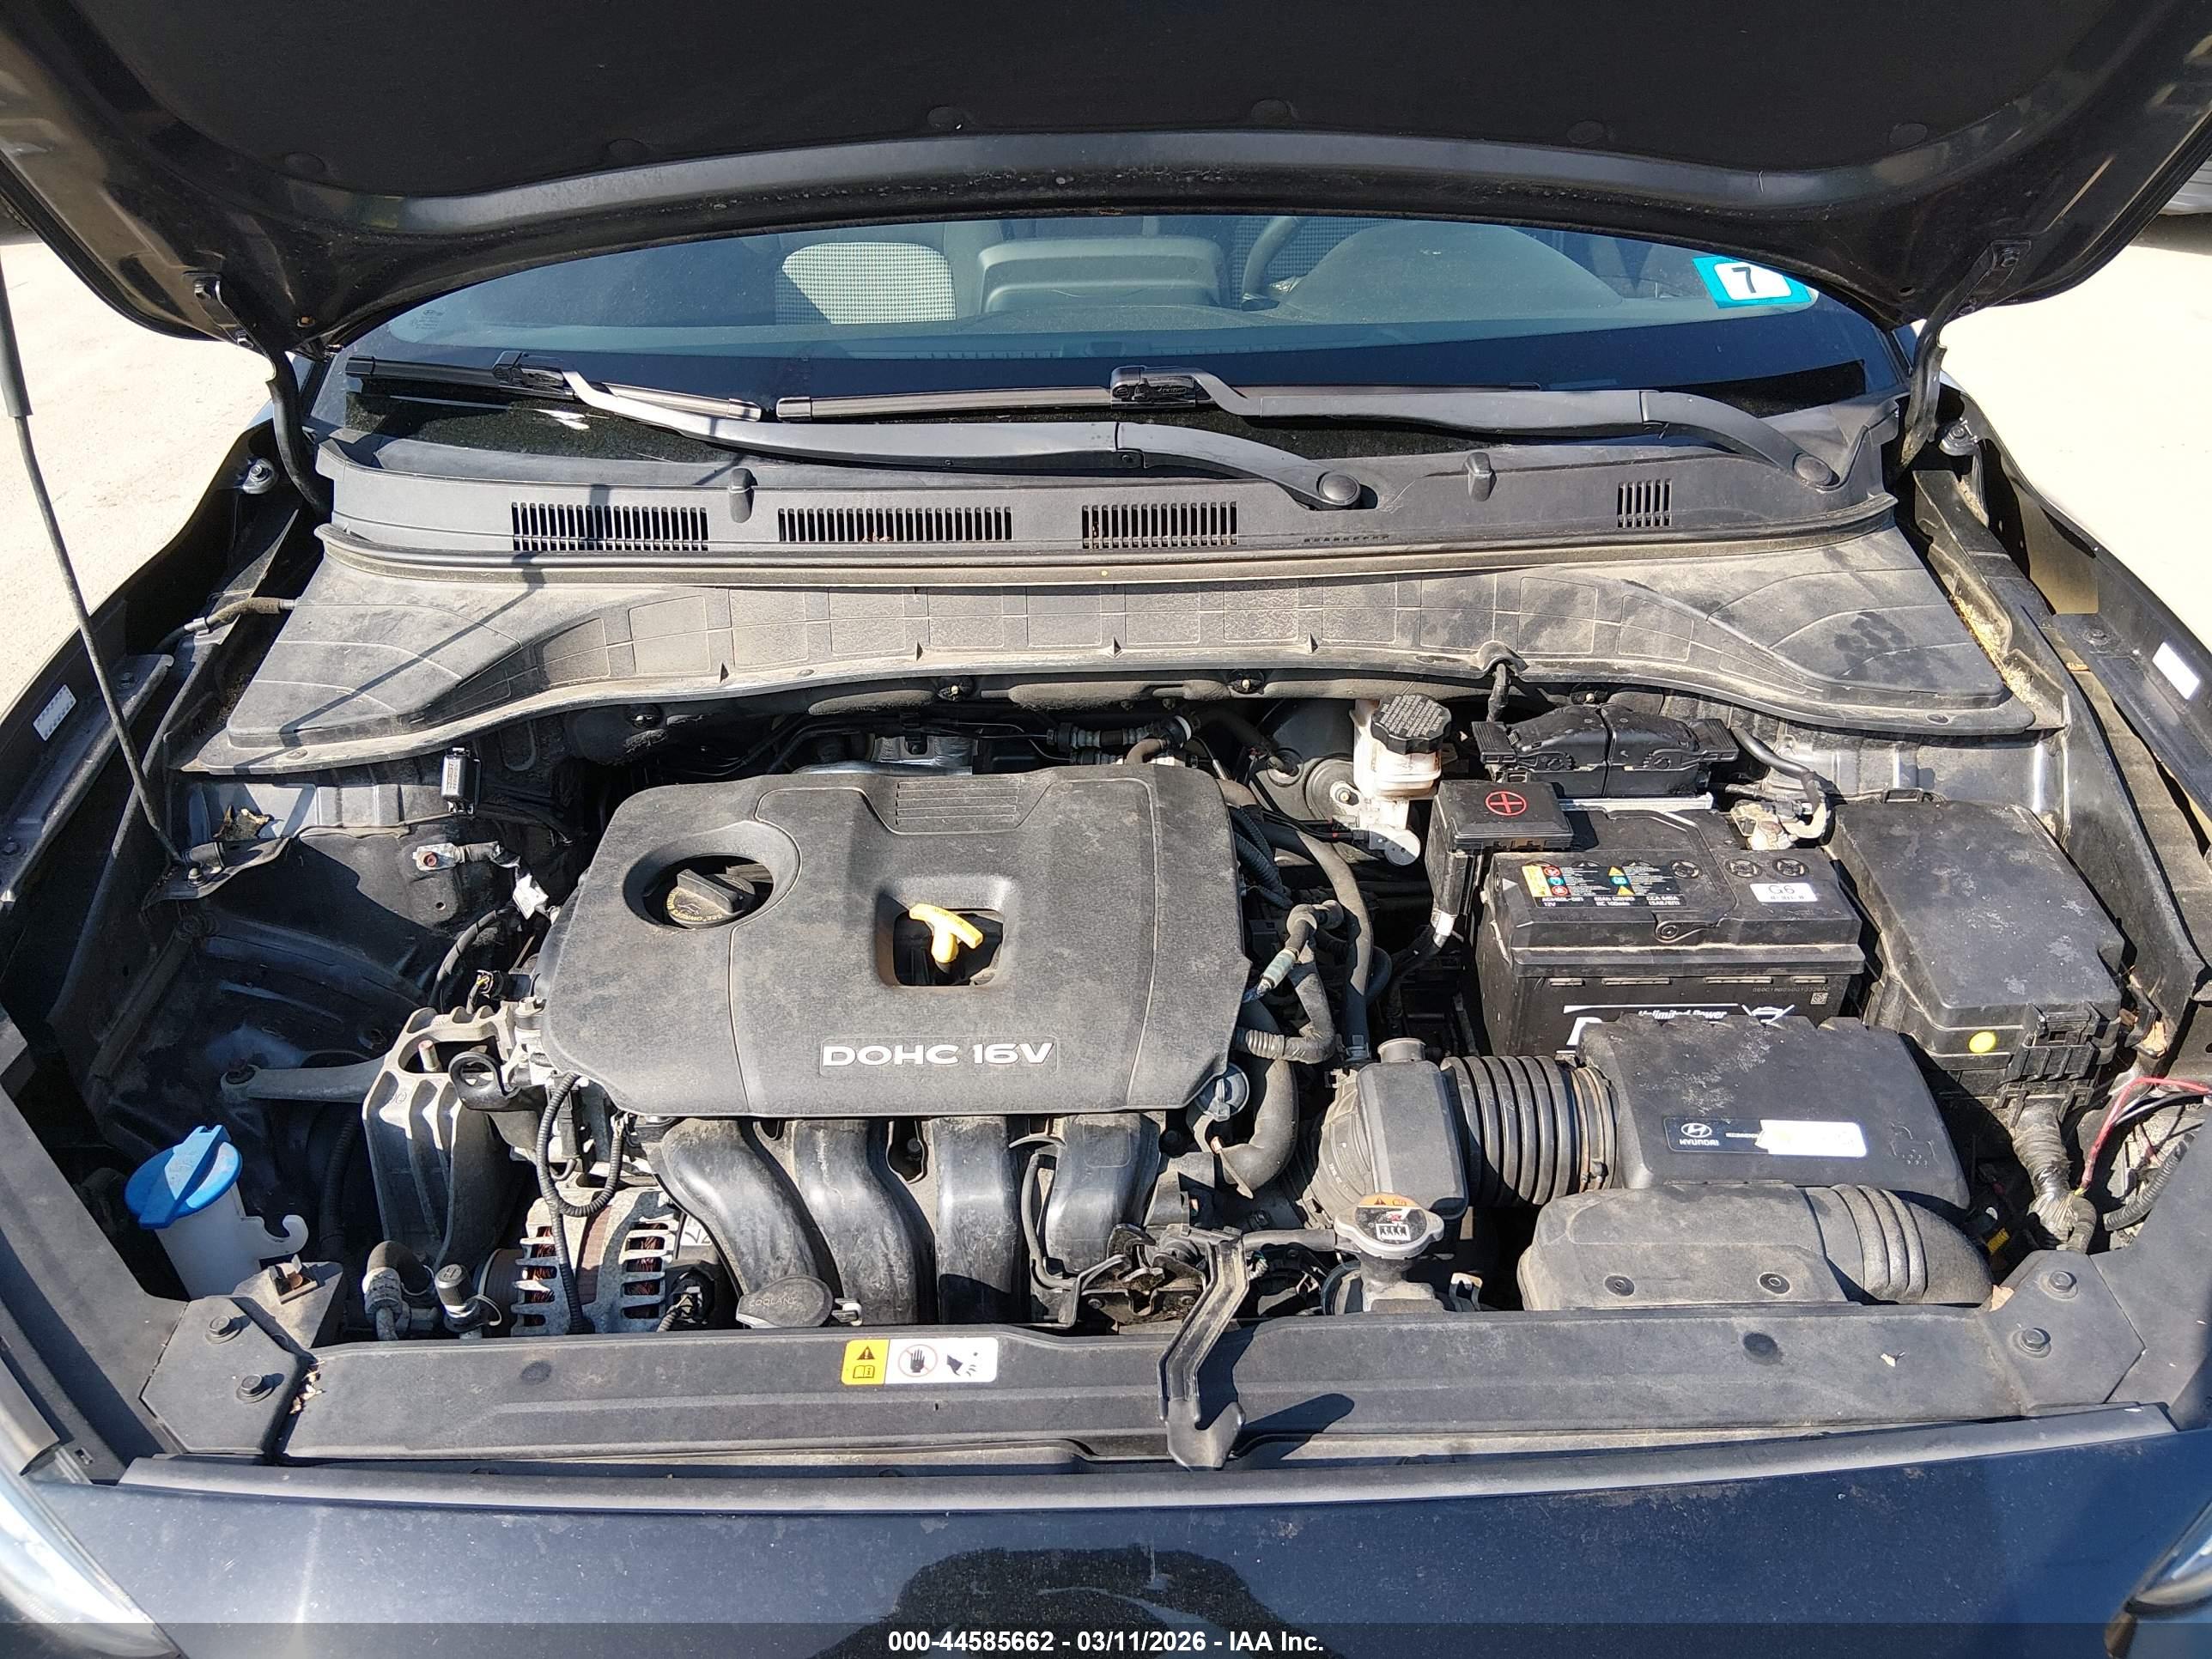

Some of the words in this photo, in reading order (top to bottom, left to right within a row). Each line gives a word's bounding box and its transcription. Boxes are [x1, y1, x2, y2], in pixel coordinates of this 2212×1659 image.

[1731, 266, 1757, 293] 7
[823, 1044, 960, 1066] DOHC
[973, 1042, 1054, 1065] 16V
[748, 1296, 799, 1307] COOLANT
